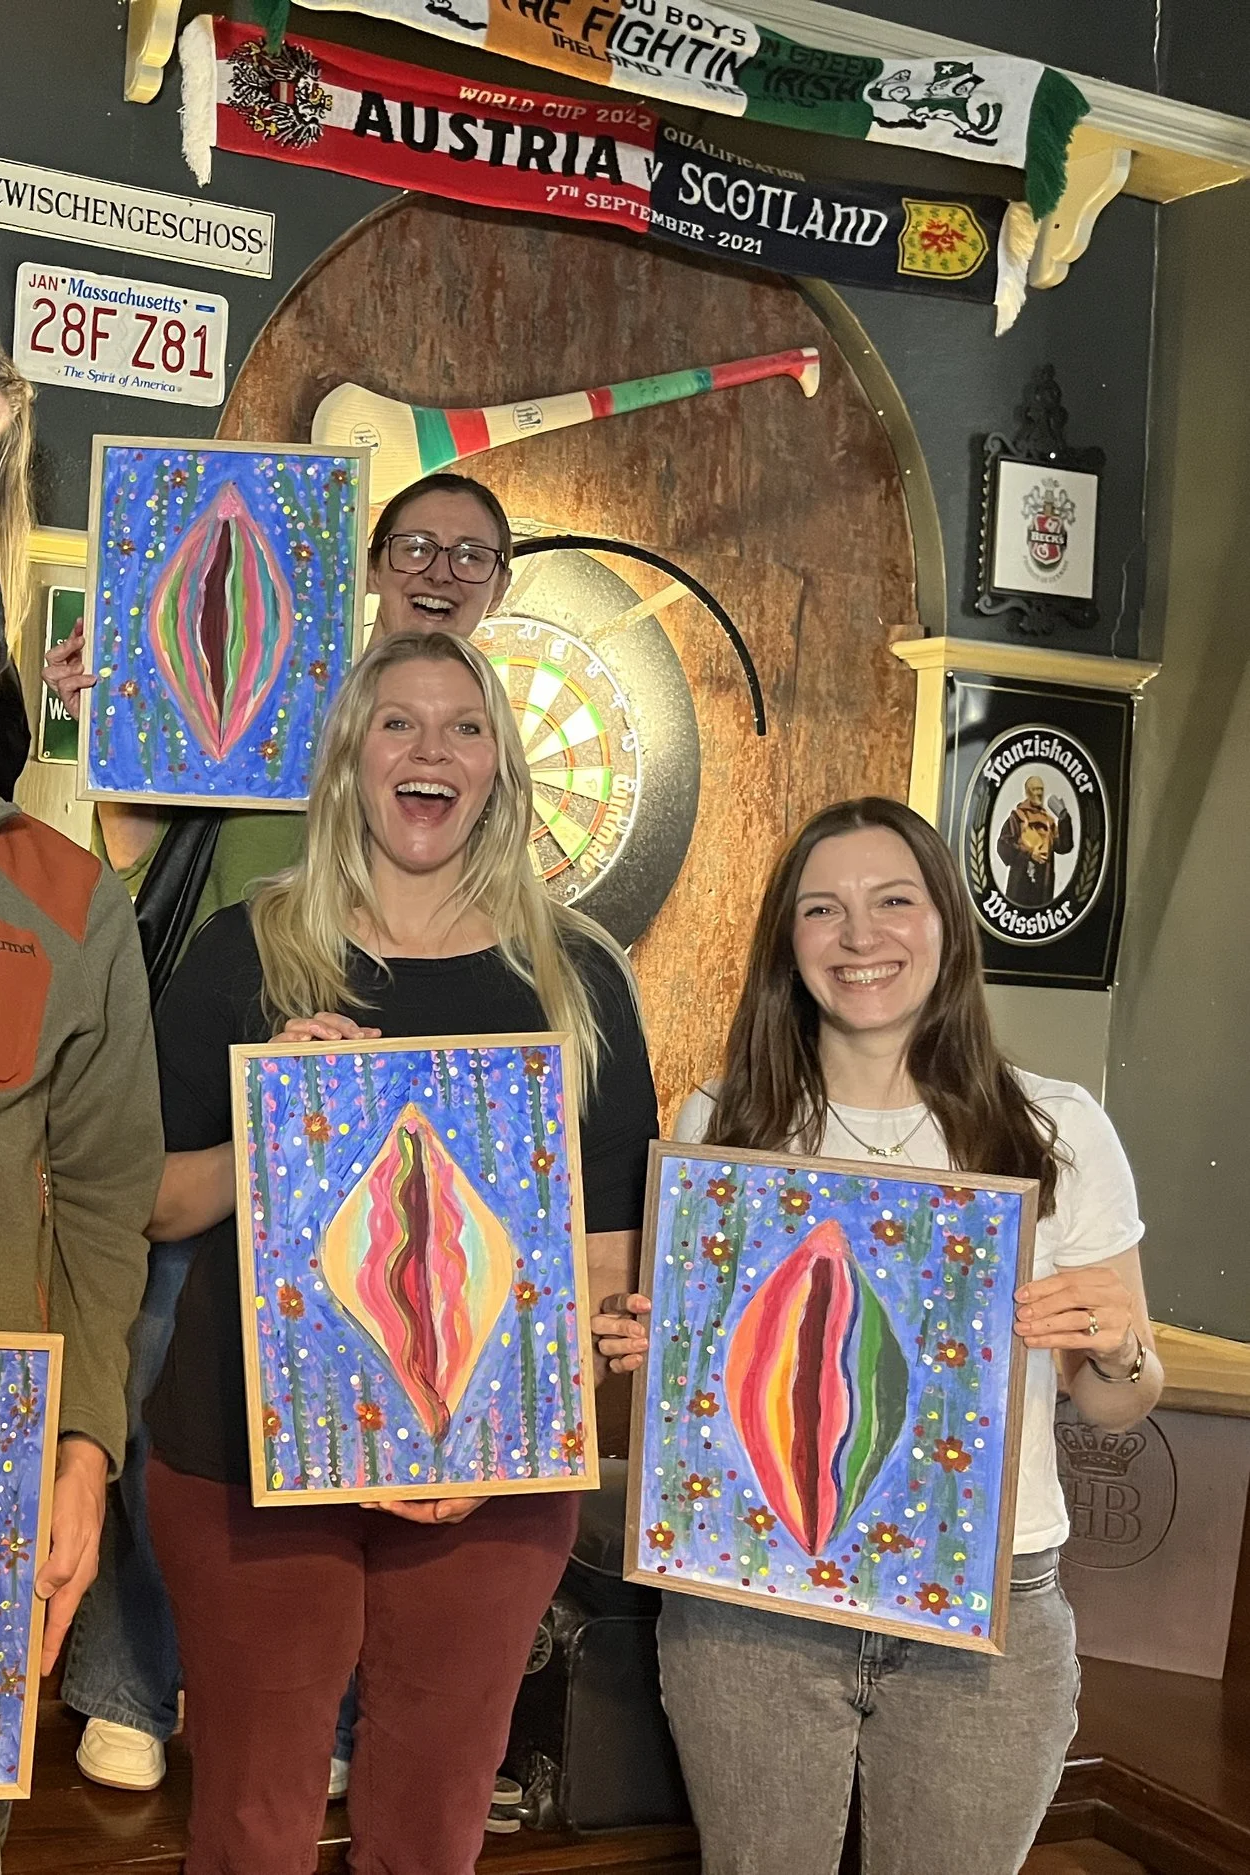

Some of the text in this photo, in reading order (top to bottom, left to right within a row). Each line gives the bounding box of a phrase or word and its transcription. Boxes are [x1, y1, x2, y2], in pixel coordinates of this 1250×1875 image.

[665, 6, 746, 46] BOYS
[552, 31, 662, 77] IRELAND
[459, 86, 652, 131] WORLD CUP 2022
[352, 90, 623, 185] AUSTRIA
[678, 162, 888, 248] SCOTLAND
[585, 192, 705, 241] SEPTEMBER
[28, 273, 182, 314] JAN Massachusetts
[29, 298, 214, 380] 28F Z81
[63, 366, 176, 393] The Spirit of America
[983, 735, 1094, 793] Franziskaner
[982, 889, 1074, 936] Weissbier
